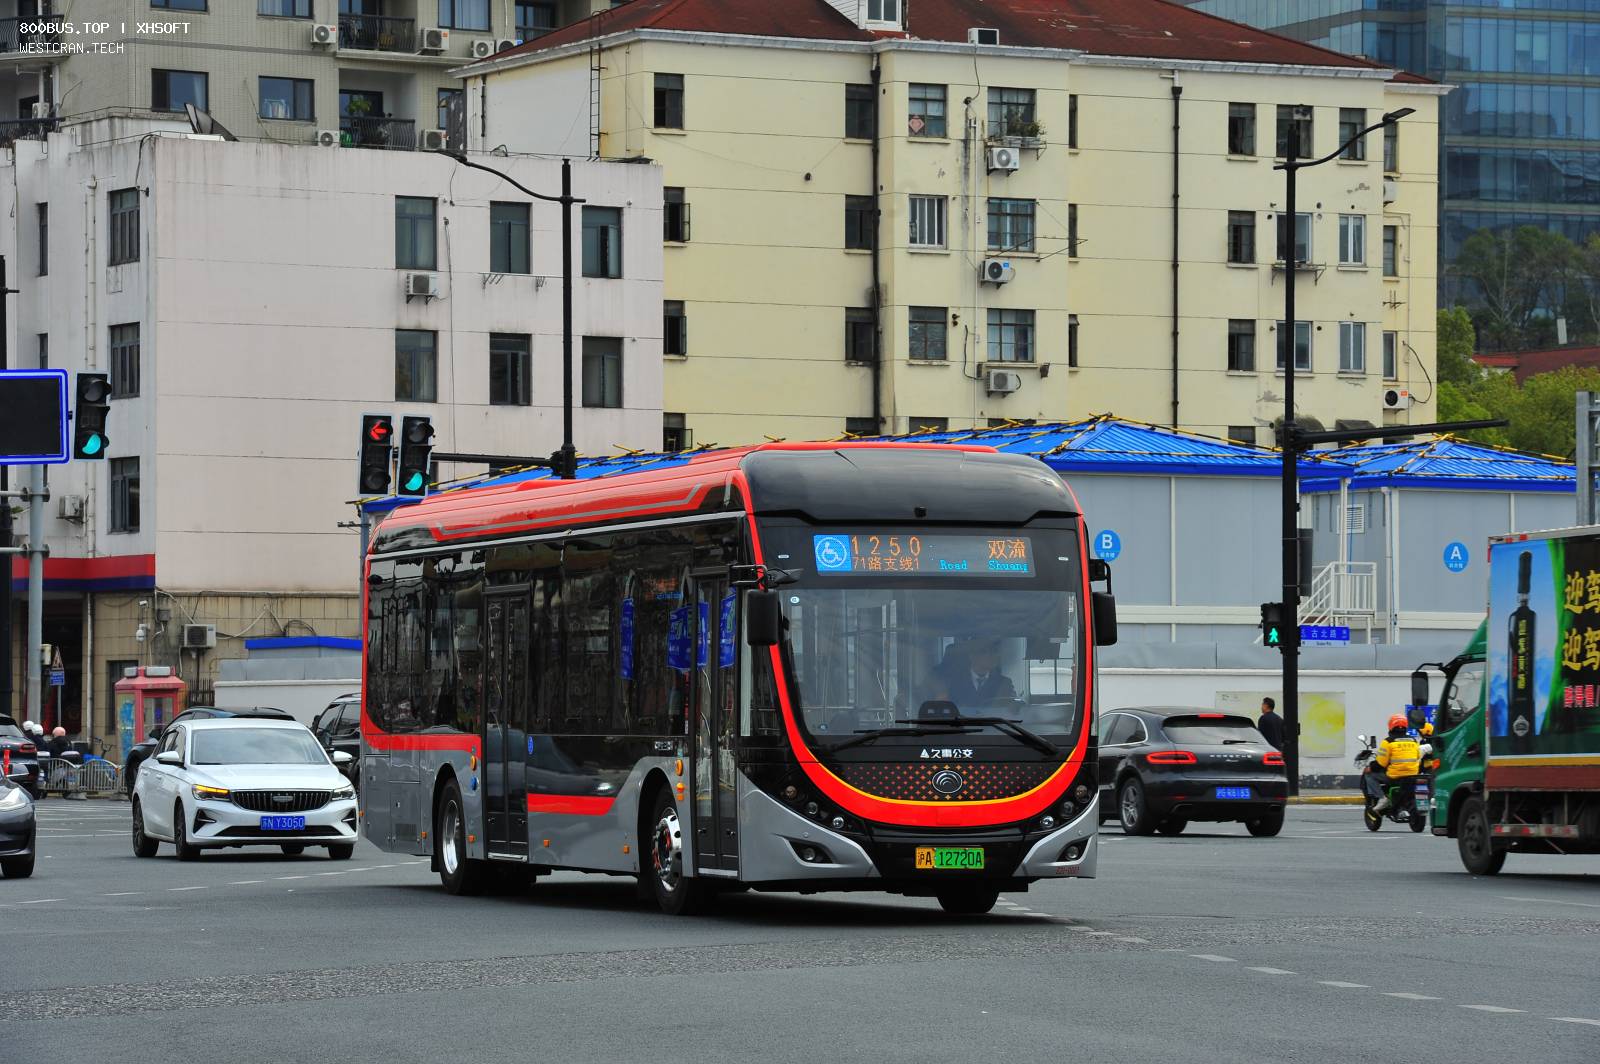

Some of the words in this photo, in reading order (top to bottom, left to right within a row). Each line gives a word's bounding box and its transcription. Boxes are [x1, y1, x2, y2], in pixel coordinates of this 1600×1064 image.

[851, 536, 921, 556] 1250
[987, 538, 1026, 559] 双流
[1102, 533, 1113, 549] B
[1450, 545, 1462, 560] A
[939, 559, 968, 570] Road
